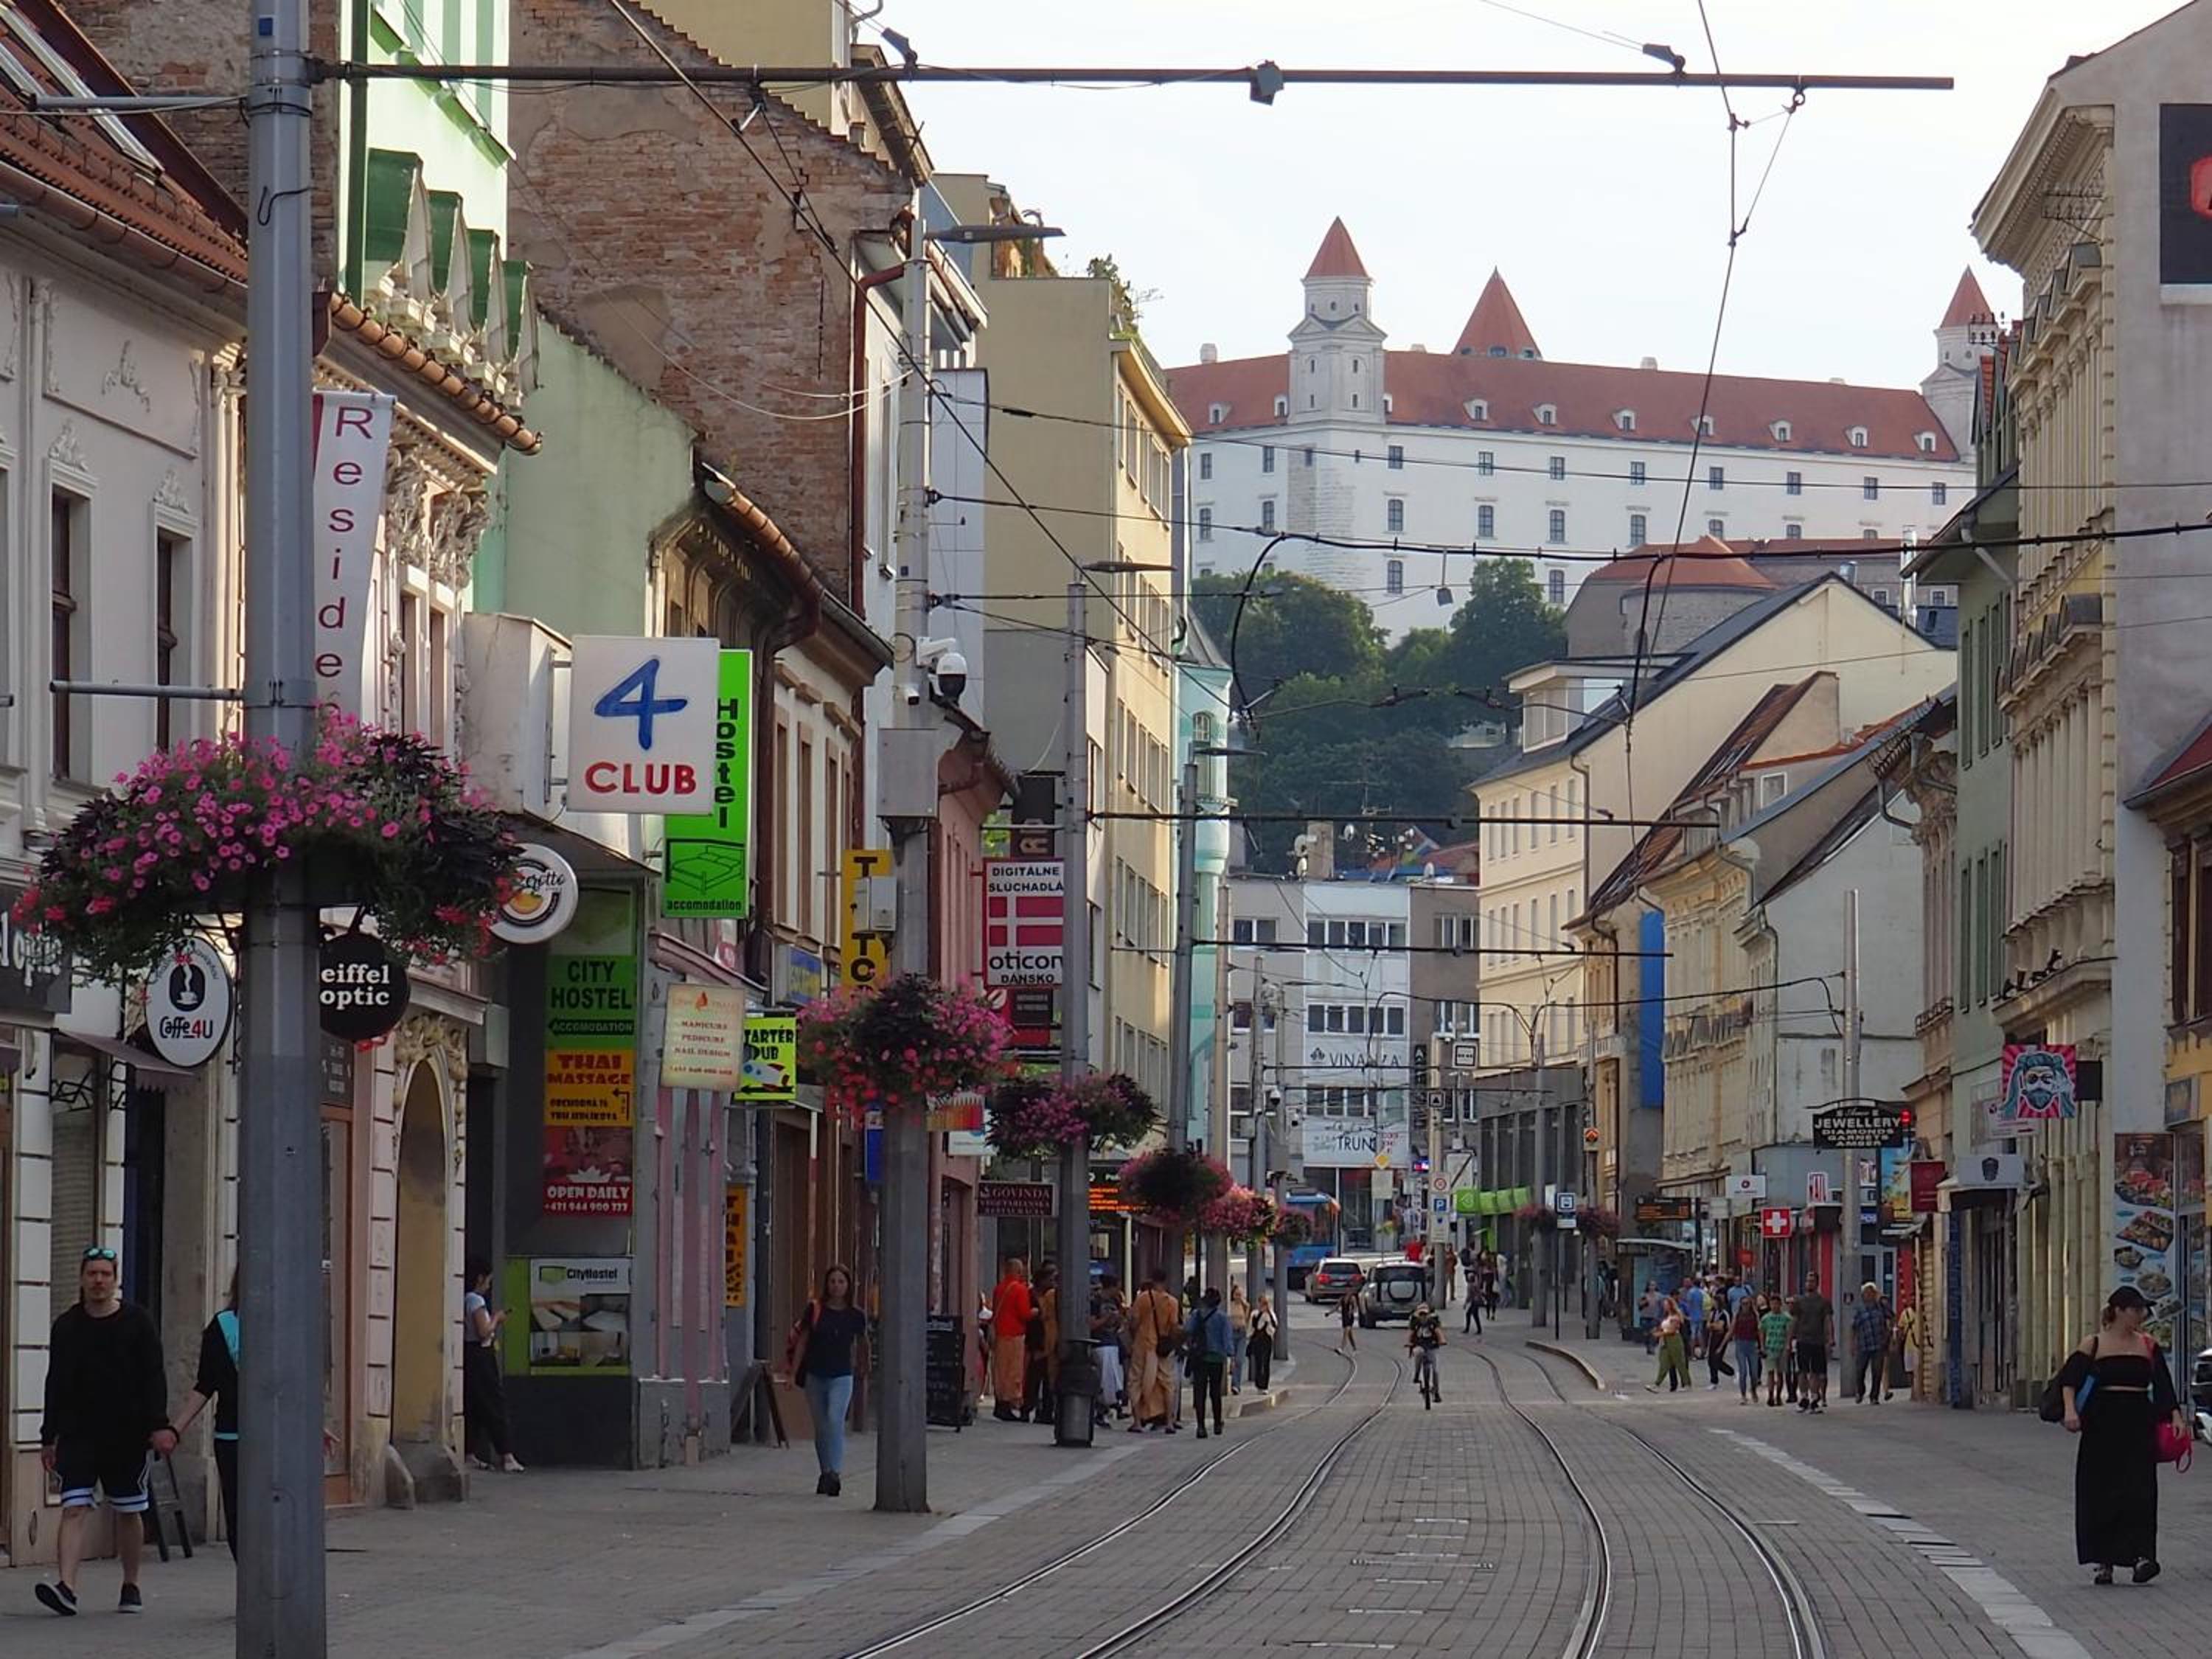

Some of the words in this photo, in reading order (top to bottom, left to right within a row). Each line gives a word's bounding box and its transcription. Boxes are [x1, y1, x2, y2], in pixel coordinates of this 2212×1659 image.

[315, 406, 373, 708] Reside
[594, 658, 687, 751] 4
[714, 698, 739, 829] Hostel
[585, 762, 698, 795] CLUB
[667, 900, 742, 911] accomodation
[989, 950, 1063, 970] oticon
[320, 963, 390, 984] eiffel
[567, 959, 616, 983] CITY
[319, 986, 390, 1010] optic
[550, 987, 633, 1009] HOSTEL
[557, 1054, 622, 1069] THAI
[547, 1073, 631, 1085] MASSAGE
[1815, 1117, 1901, 1129] JEWELLERY
[547, 1185, 585, 1199] OPEN
[587, 1186, 630, 1200] DAILY
[992, 1187, 1050, 1198] GOVINDA
